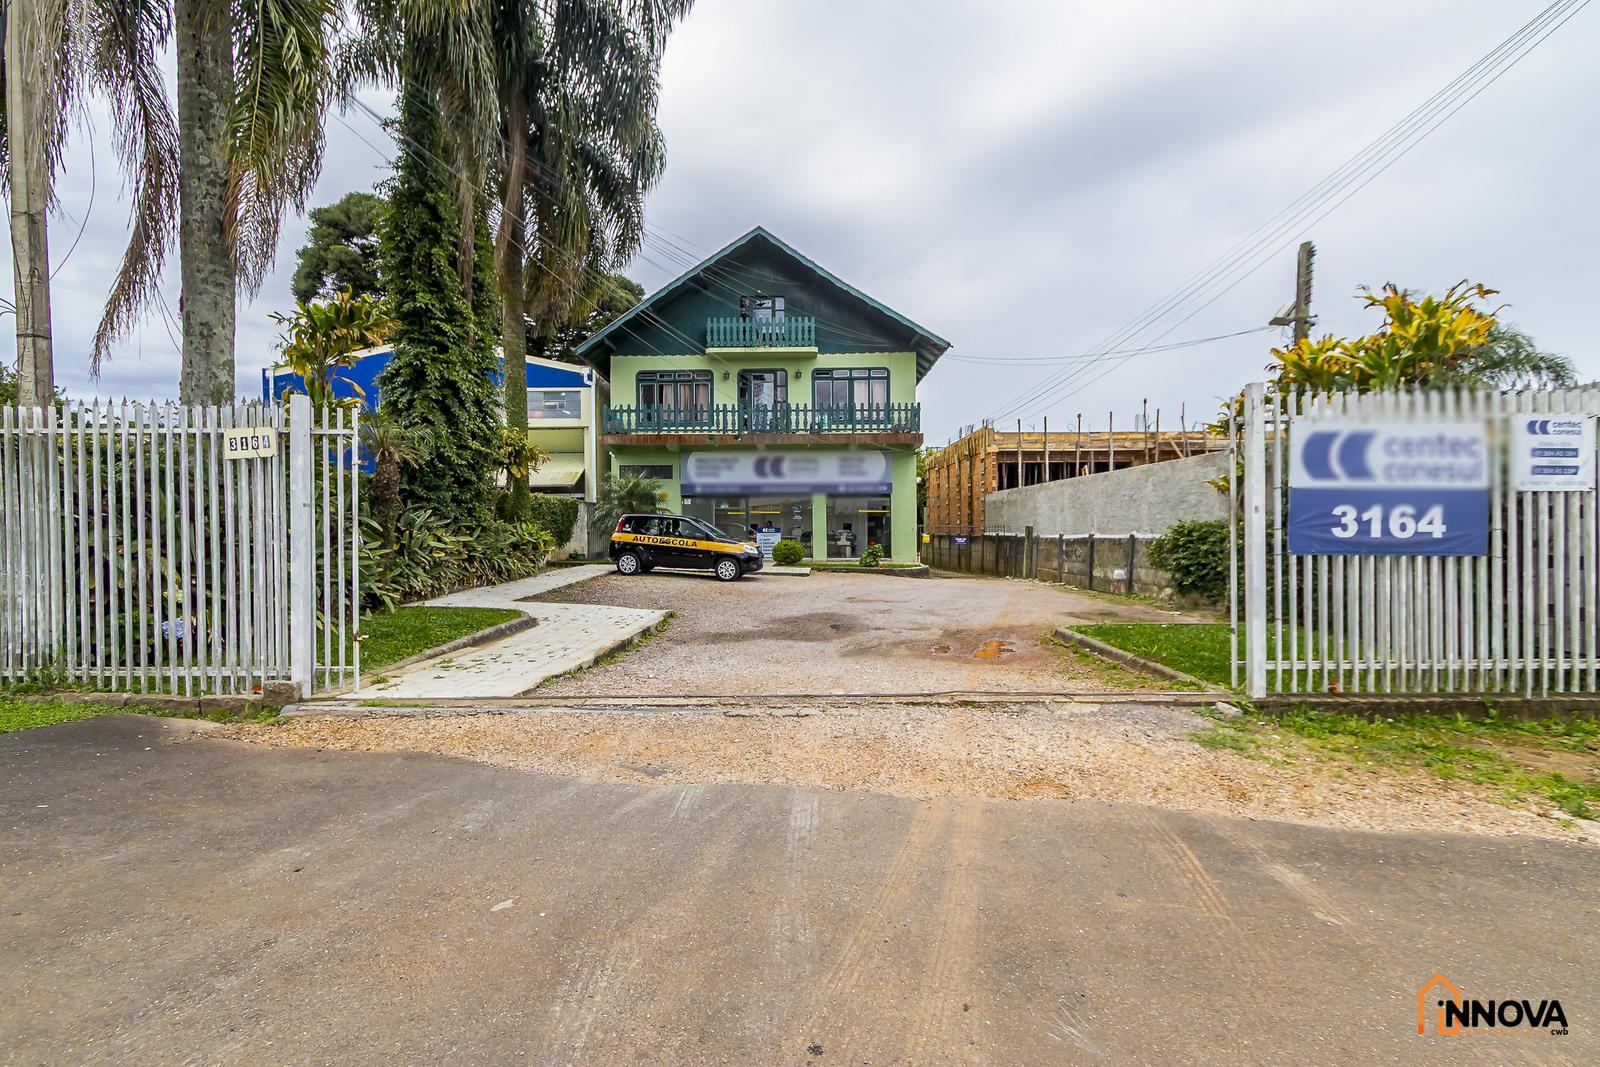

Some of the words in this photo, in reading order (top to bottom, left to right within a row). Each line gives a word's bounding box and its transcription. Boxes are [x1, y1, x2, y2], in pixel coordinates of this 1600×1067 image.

[229, 435, 270, 450] 3164
[1383, 433, 1481, 457] centec
[1330, 504, 1447, 539] 3164
